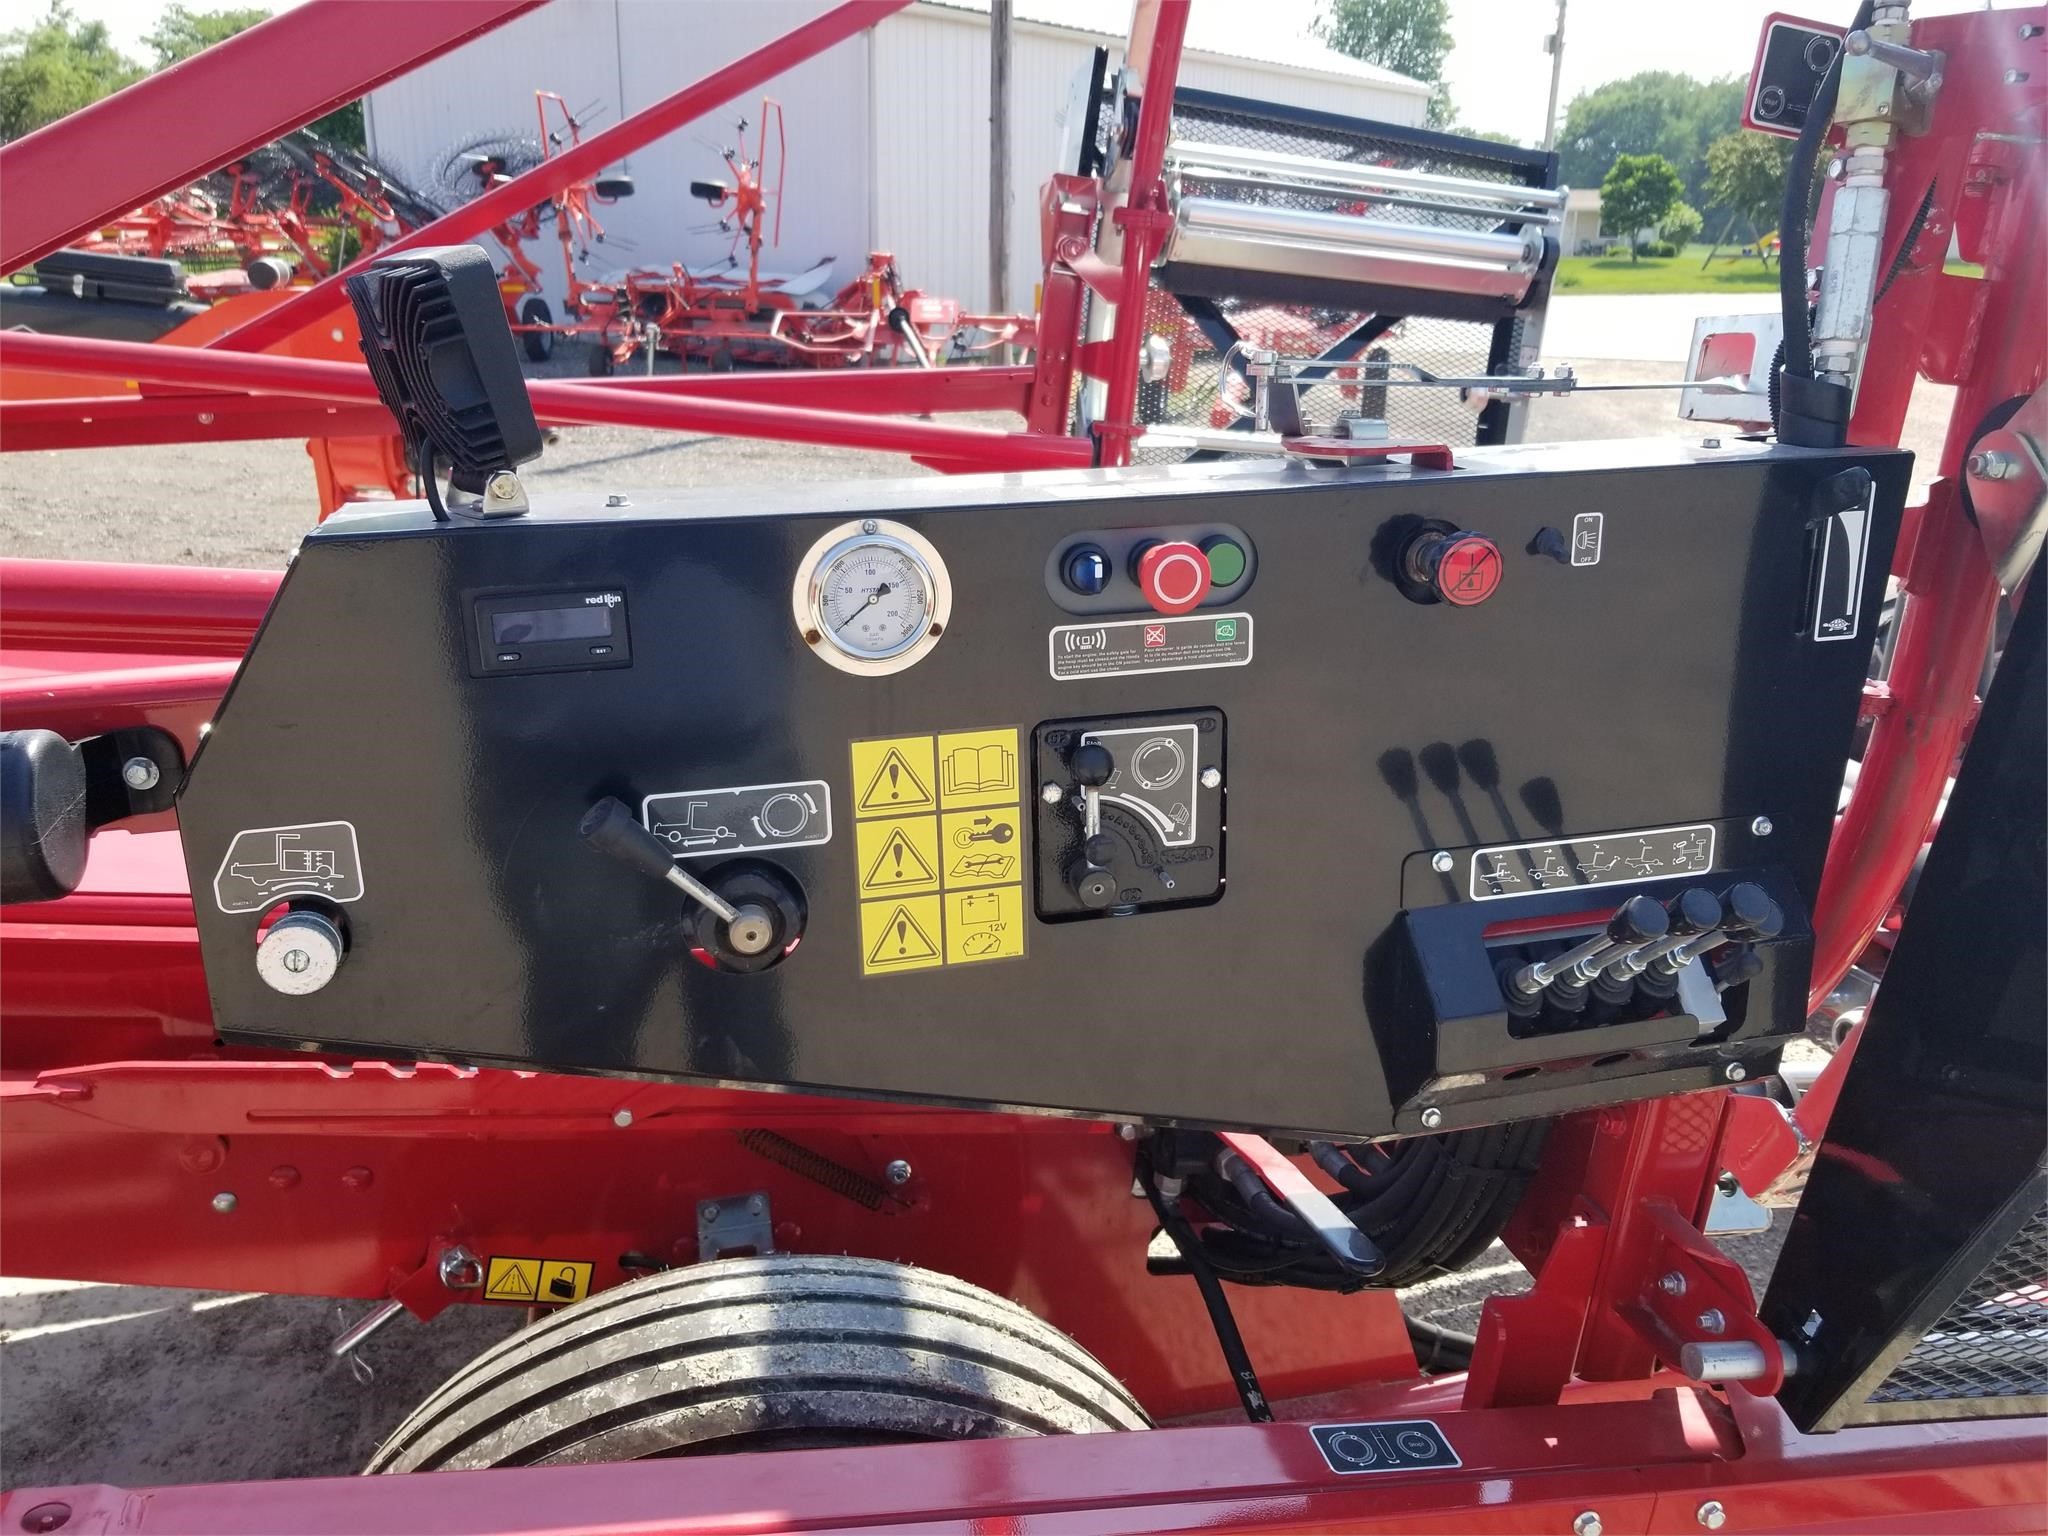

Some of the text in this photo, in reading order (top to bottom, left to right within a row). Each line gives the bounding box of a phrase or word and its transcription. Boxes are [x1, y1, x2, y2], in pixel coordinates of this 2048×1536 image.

[833, 561, 845, 573] 1000
[899, 557, 912, 571] 2000
[586, 593, 621, 608] red lion
[901, 624, 914, 637] 3000
[988, 922, 1007, 932] 12V
